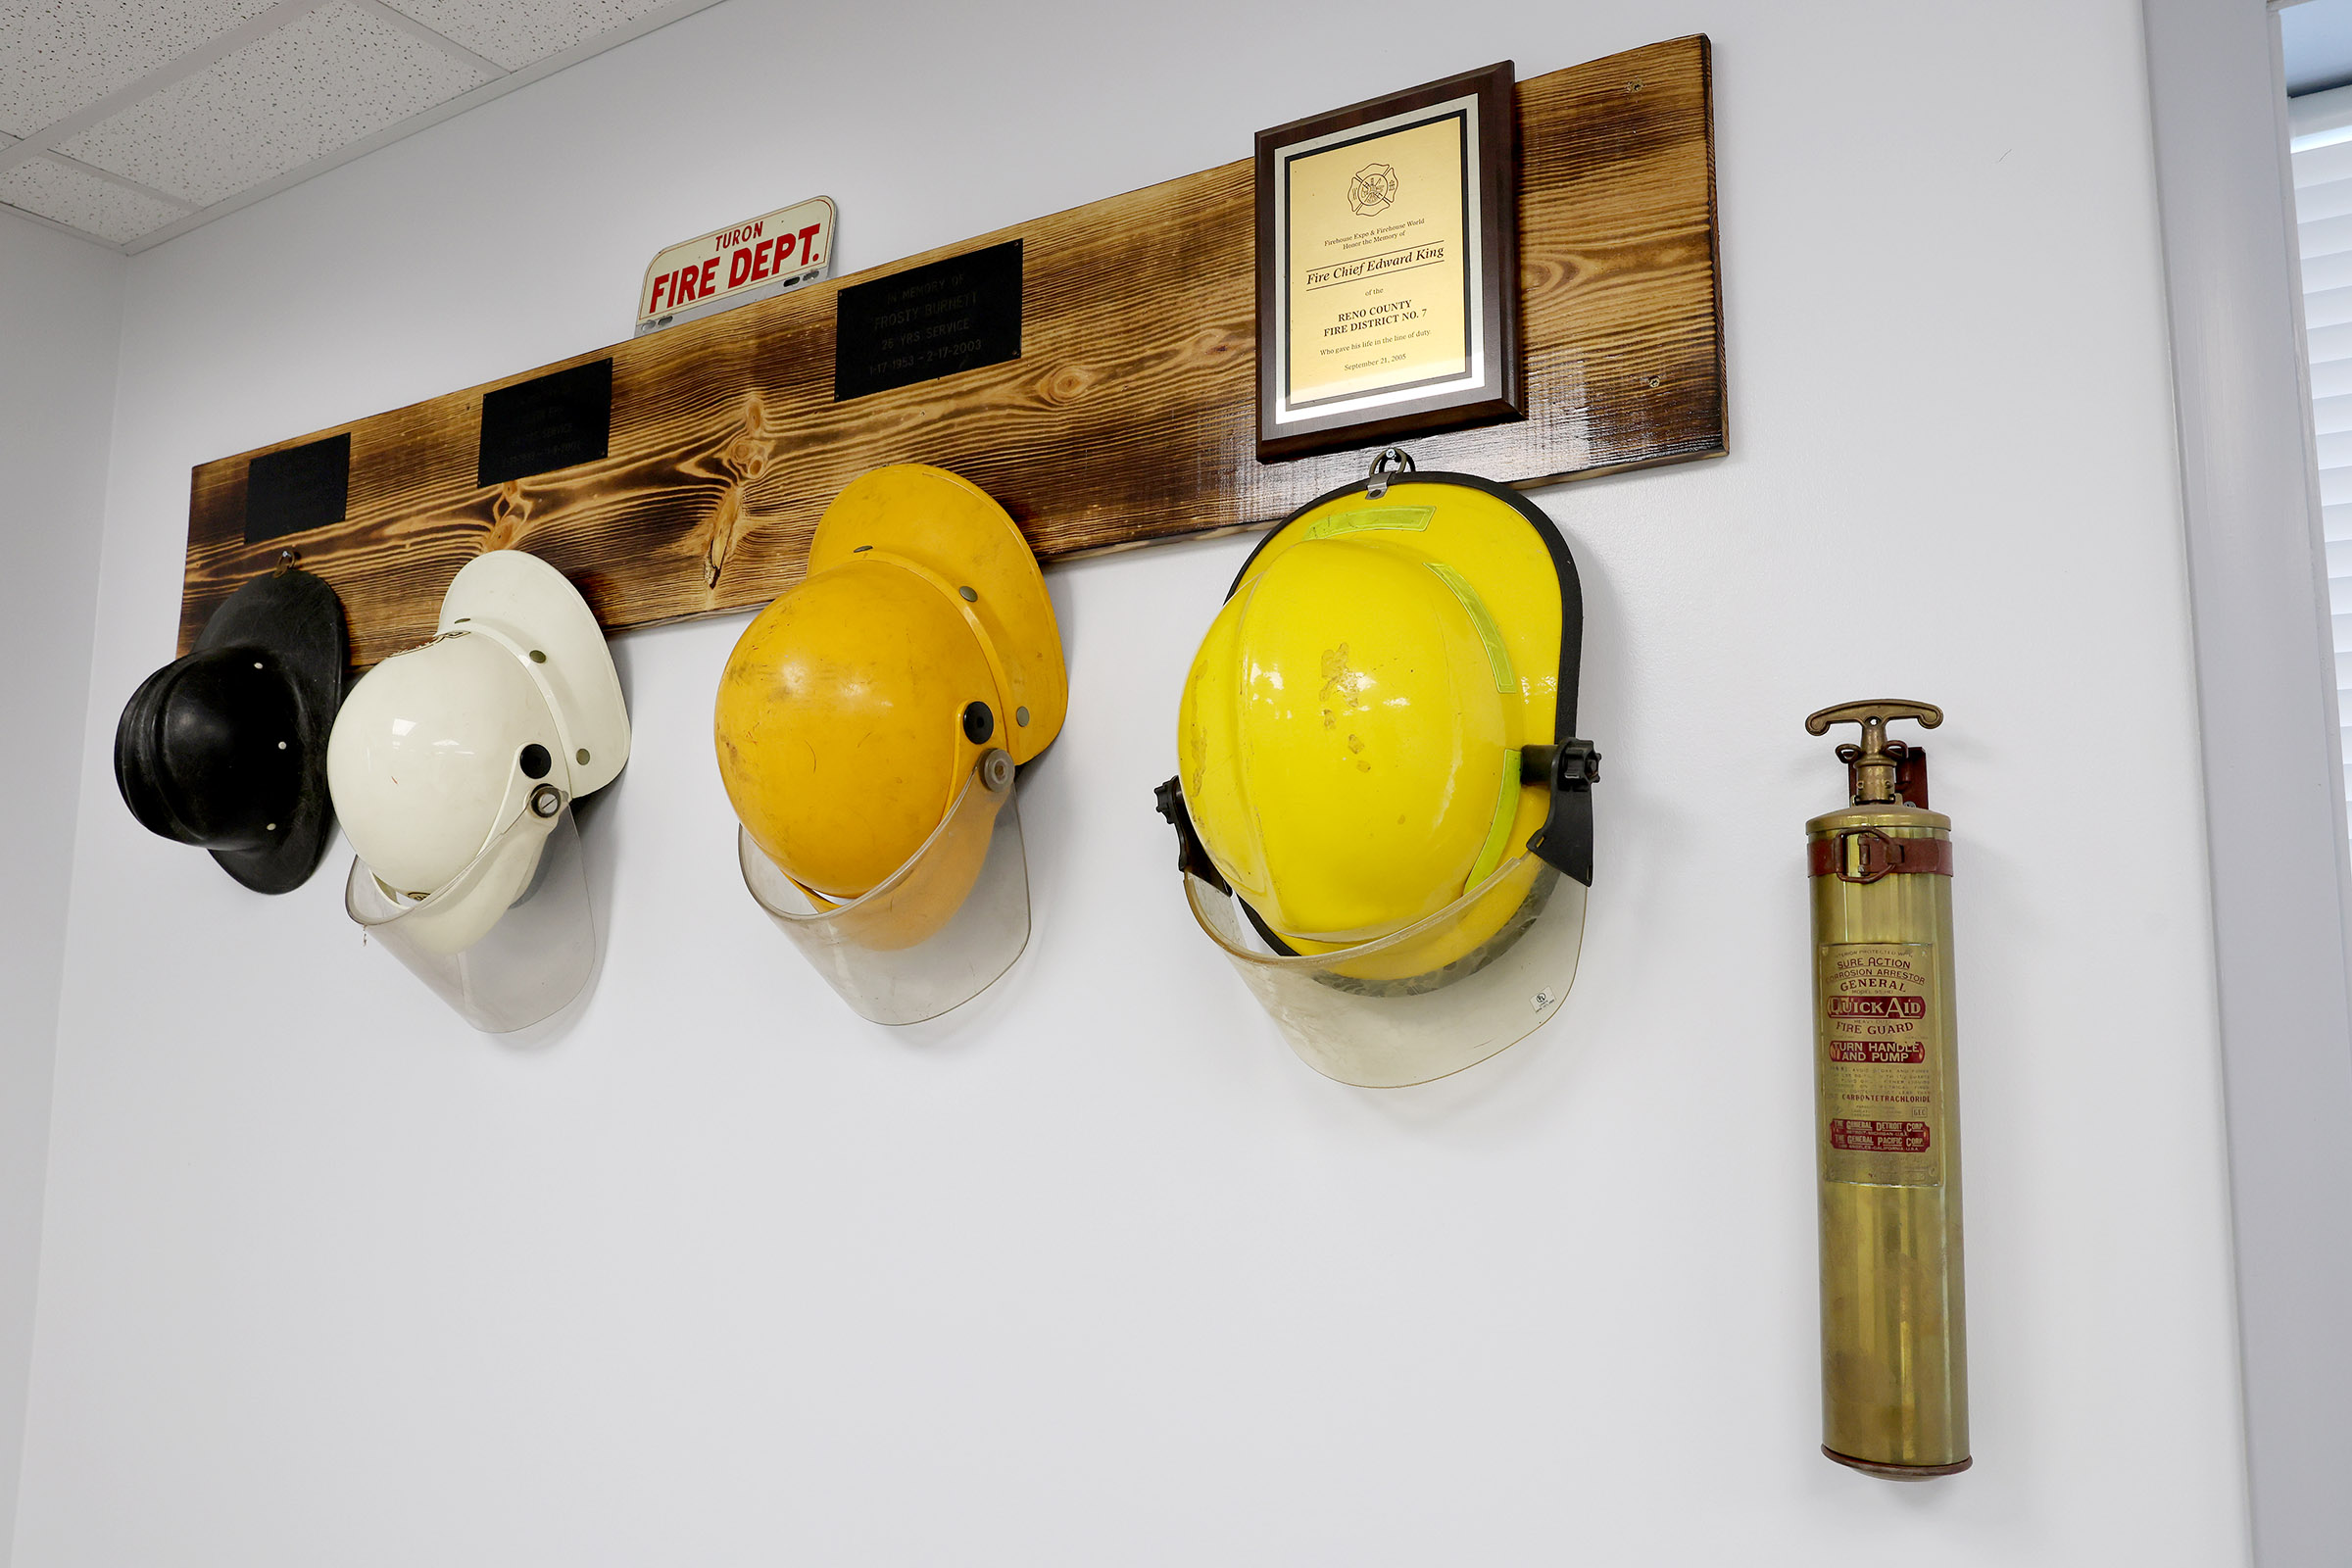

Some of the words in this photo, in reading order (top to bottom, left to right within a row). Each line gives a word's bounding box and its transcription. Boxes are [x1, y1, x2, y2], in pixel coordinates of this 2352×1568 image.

[715, 220, 763, 252] TURON
[1324, 235, 1352, 247] Firehouse
[1353, 231, 1369, 240] Expo
[1376, 222, 1405, 234] Firehouse
[1406, 218, 1425, 227] World
[1343, 240, 1361, 250] Honor
[1373, 232, 1397, 243] Memory
[649, 256, 720, 314] FIRE
[728, 223, 821, 289] DEPT.
[1306, 271, 1330, 285] Fire
[1333, 262, 1366, 279] Chief
[1366, 252, 1413, 271] Edward
[1415, 247, 1445, 261] King
[903, 278, 946, 300] MEMORY
[874, 308, 919, 331] FROSTY
[1338, 309, 1367, 322] RENO
[1369, 299, 1412, 316] COUNTY
[1323, 324, 1348, 337] FIRE
[1349, 314, 1399, 332] DISTRICT
[1401, 310, 1419, 322] NO.
[1421, 308, 1428, 318] 7
[900, 330, 921, 347] YRS
[926, 317, 970, 339] SERVICE
[1319, 348, 1334, 357] Who
[1335, 344, 1350, 355] gave
[1350, 341, 1361, 350] his
[1362, 339, 1373, 348] life
[1344, 360, 1379, 371] September
[1380, 356, 1391, 366] 21,
[1391, 353, 1407, 364] 2005
[1837, 957, 1864, 969] SURE
[1868, 956, 1911, 969] ACTION
[1826, 968, 1873, 984] CORROSION
[1877, 968, 1926, 985] ARRESTOR
[1840, 978, 1907, 993] GENERAL
[1836, 1021, 1862, 1034] FIRE
[1867, 1021, 1914, 1035] GUARD
[1833, 1042, 1863, 1052] TURN
[1868, 1042, 1920, 1053] HANDLE
[1841, 1052, 1867, 1061] AND
[1871, 1053, 1909, 1062] PUMP
[1876, 1121, 1902, 1131] DETROIT
[1847, 1136, 1874, 1146] GENERAL
[1878, 1137, 1902, 1147] PACIFIC
